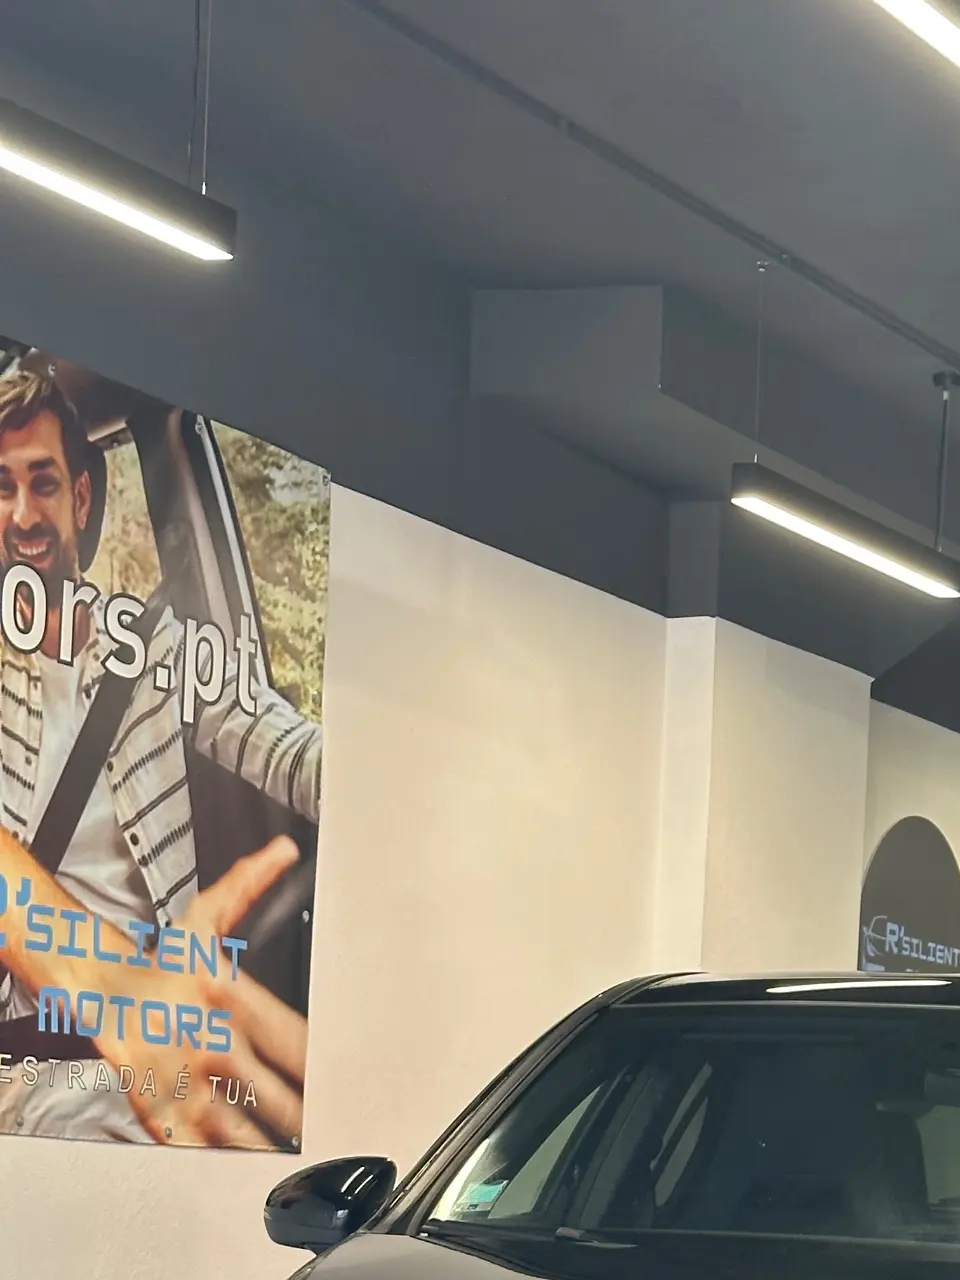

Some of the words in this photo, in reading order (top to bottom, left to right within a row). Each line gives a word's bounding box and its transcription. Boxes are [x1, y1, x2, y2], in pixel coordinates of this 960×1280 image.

[0, 563, 257, 725] ors.pt
[0, 873, 248, 981] 'SILIENT
[885, 922, 960, 968] R'SILIENT
[38, 985, 233, 1053] MOTORS
[173, 1064, 191, 1100] É
[208, 1075, 258, 1107] TUA
